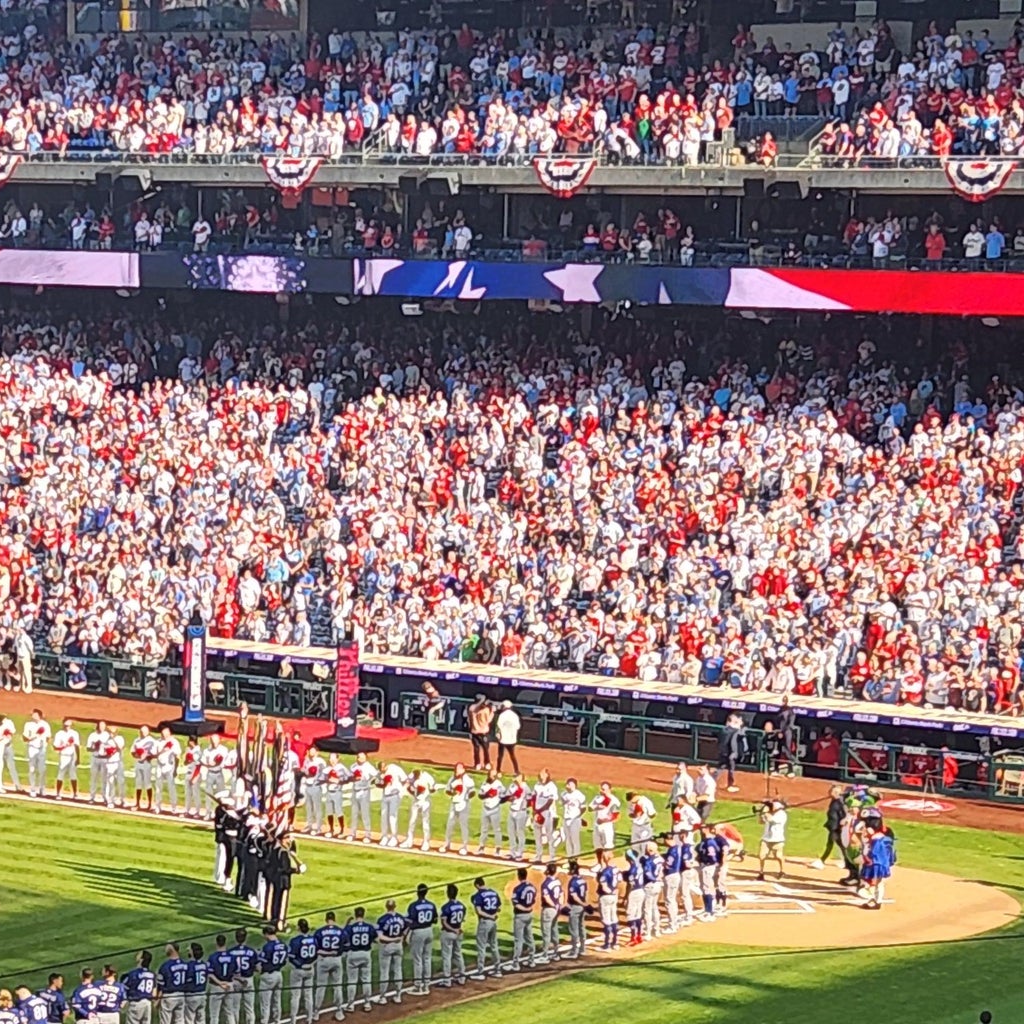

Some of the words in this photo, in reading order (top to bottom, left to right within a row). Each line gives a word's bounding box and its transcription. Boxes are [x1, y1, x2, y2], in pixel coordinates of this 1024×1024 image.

[484, 897, 497, 910] 32
[418, 911, 433, 924] 80
[450, 911, 464, 924] 20
[389, 924, 401, 936] 13
[322, 936, 339, 949] 62
[352, 933, 369, 946] 68
[273, 950, 287, 965] 67
[300, 945, 316, 958] 60
[173, 971, 186, 986] 31
[138, 979, 154, 994] 48
